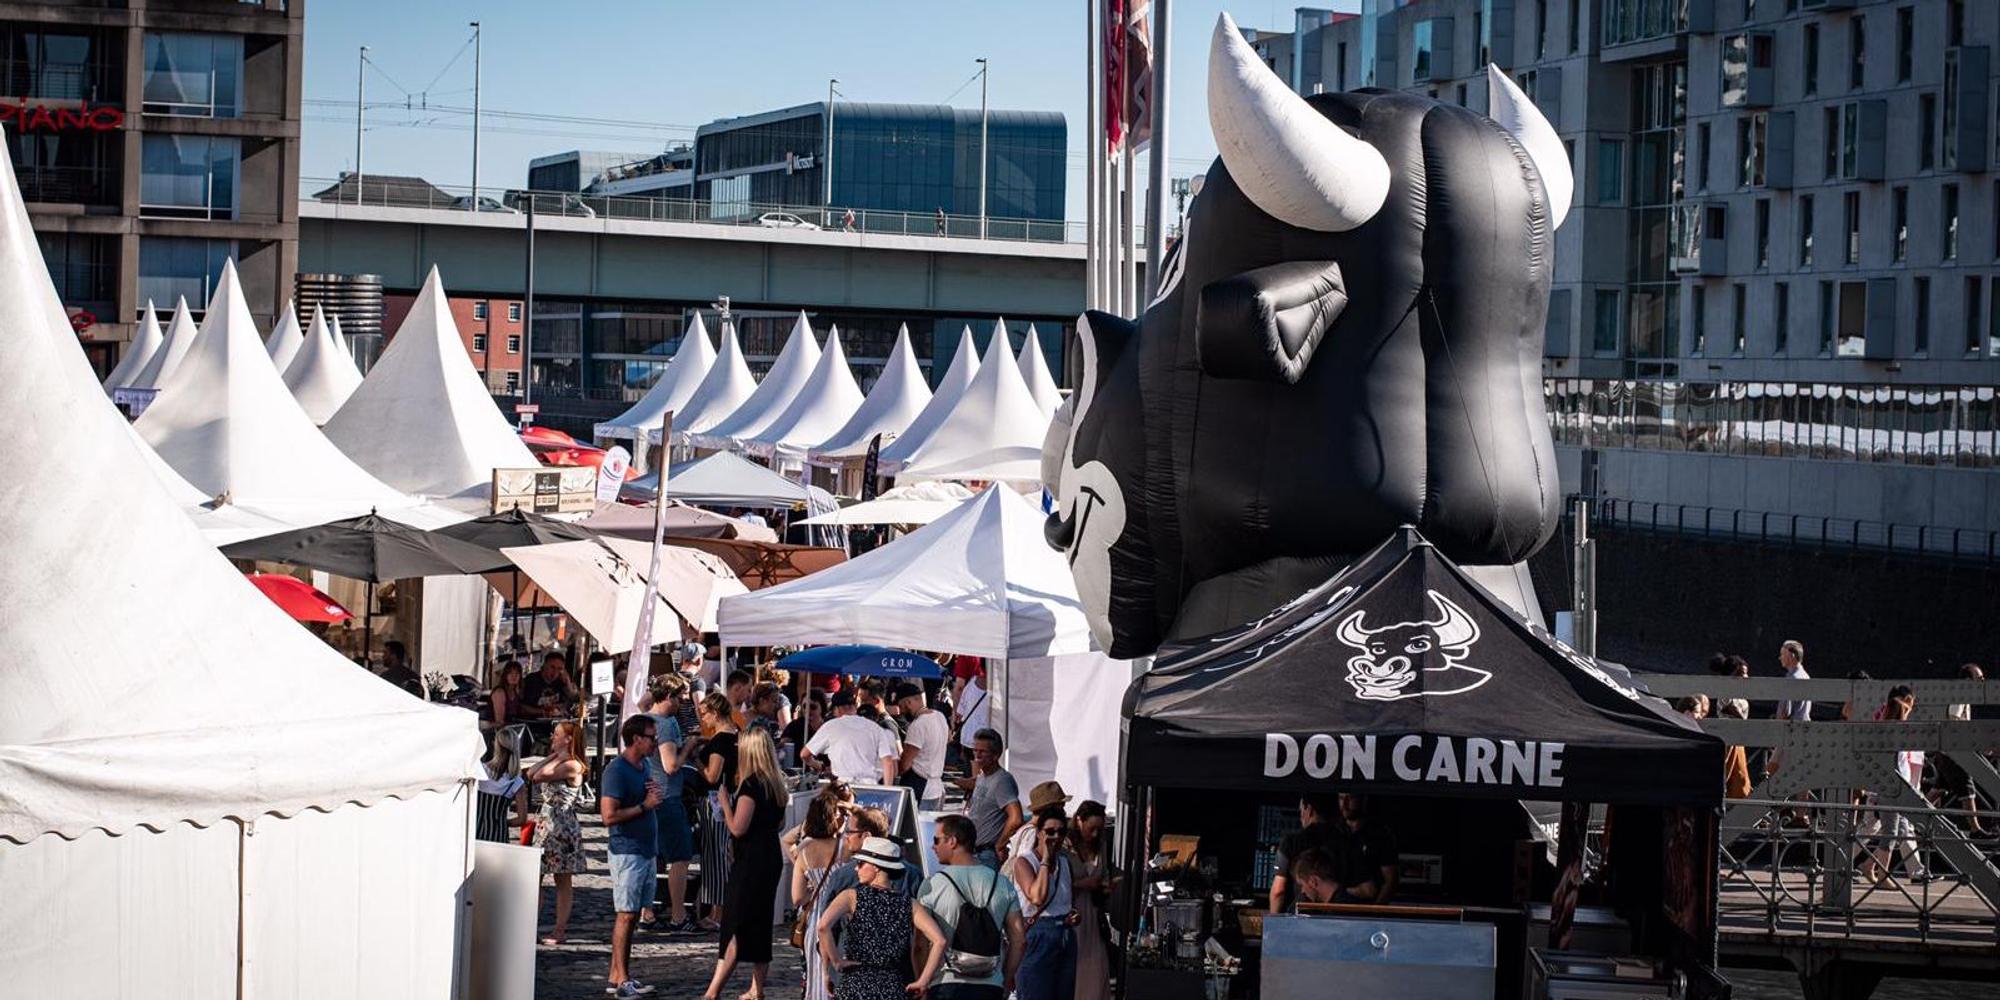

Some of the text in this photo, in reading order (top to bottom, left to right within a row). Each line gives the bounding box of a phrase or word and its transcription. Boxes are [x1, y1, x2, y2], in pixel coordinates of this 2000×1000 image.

[881, 657, 913, 669] GROM
[1264, 733, 1566, 787] DON CARNE
